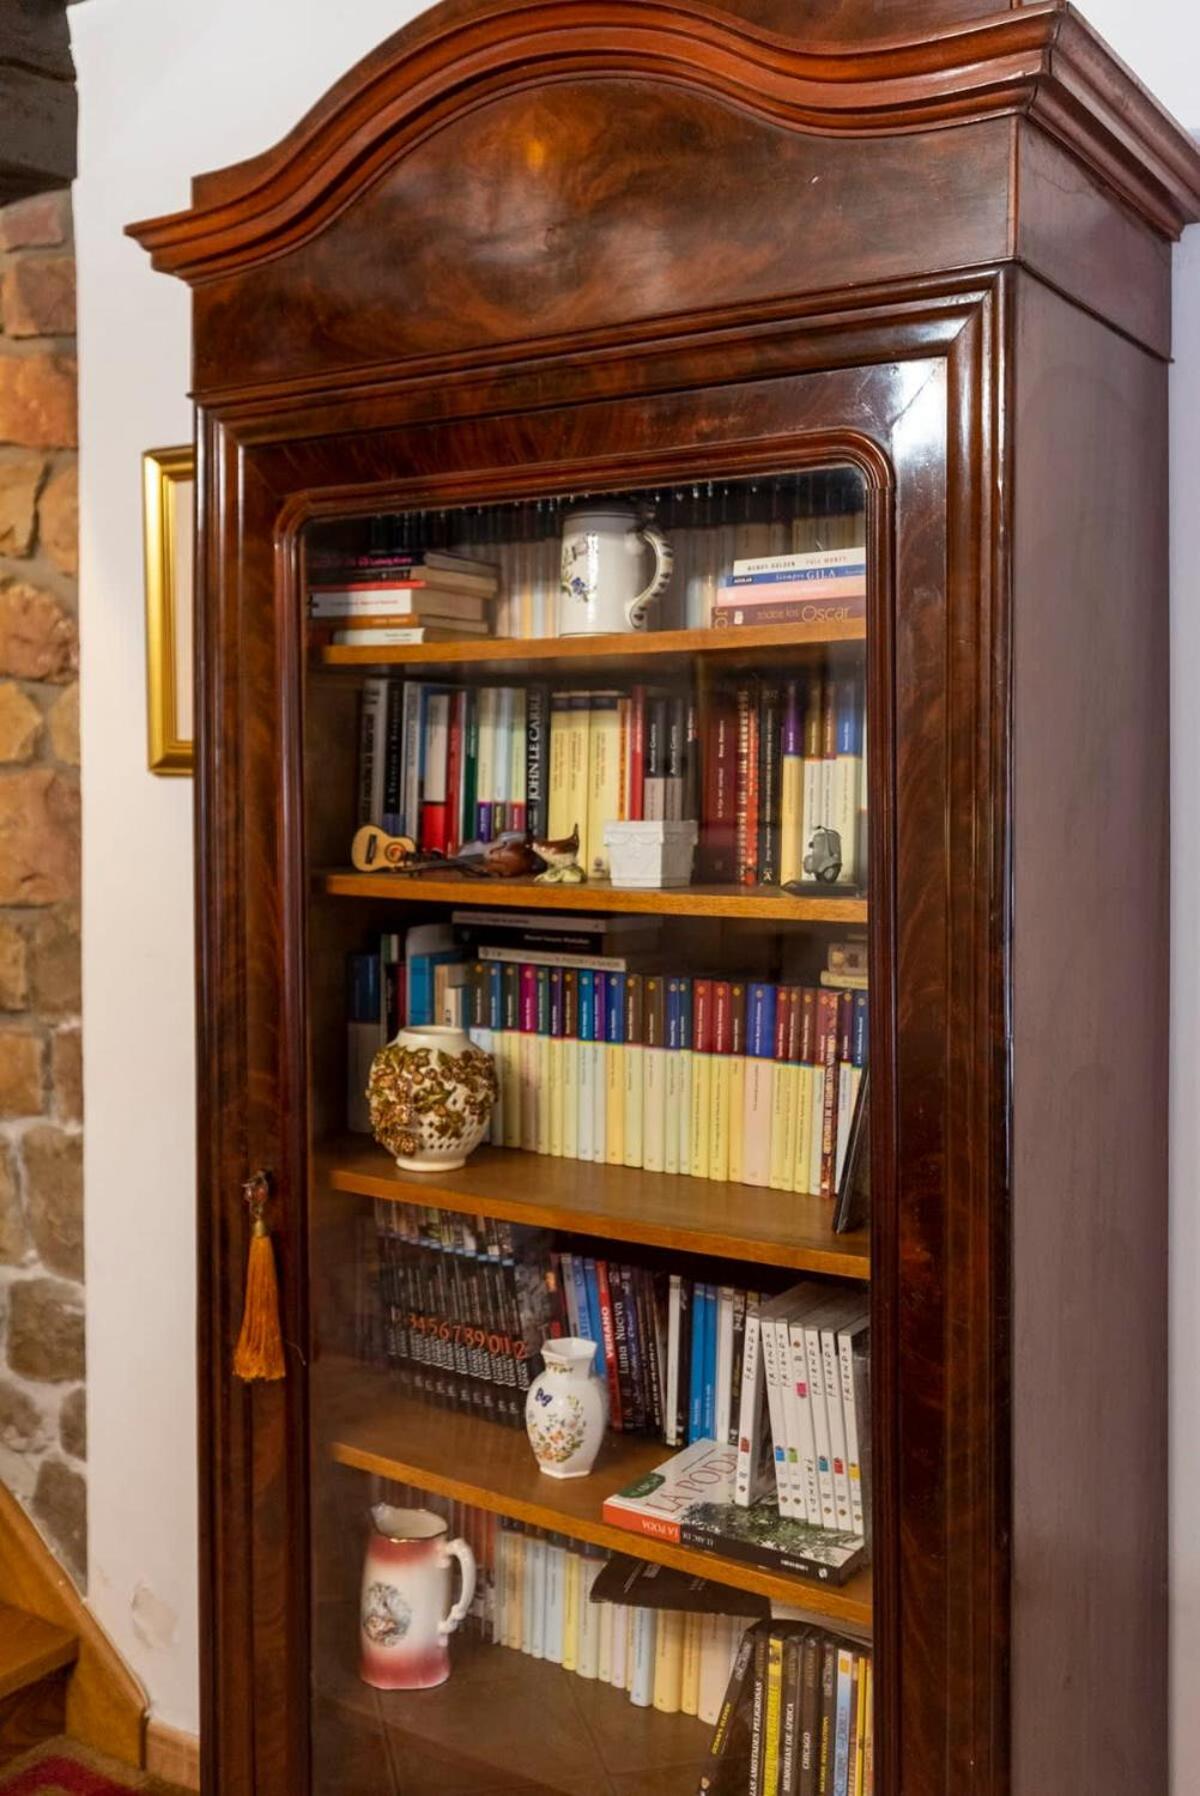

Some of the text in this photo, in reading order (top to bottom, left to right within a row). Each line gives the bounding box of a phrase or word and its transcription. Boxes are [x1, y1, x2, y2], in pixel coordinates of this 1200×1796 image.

[806, 569, 837, 581] GILA
[801, 604, 850, 624] Oscar
[527, 742, 541, 760] LE
[527, 762, 541, 800] JOHN
[601, 1306, 616, 1360] VERANO
[614, 1301, 630, 1375] Luna Nueva
[646, 1492, 684, 1514] LA
[675, 1452, 738, 1493] PODA
[753, 1681, 763, 1732] PELIGROSAS
[751, 1732, 761, 1780] AMISTADES
[783, 1703, 794, 1792] MEMORIAS DE ÁFRICA
[802, 1731, 811, 1770] CHICAGO
